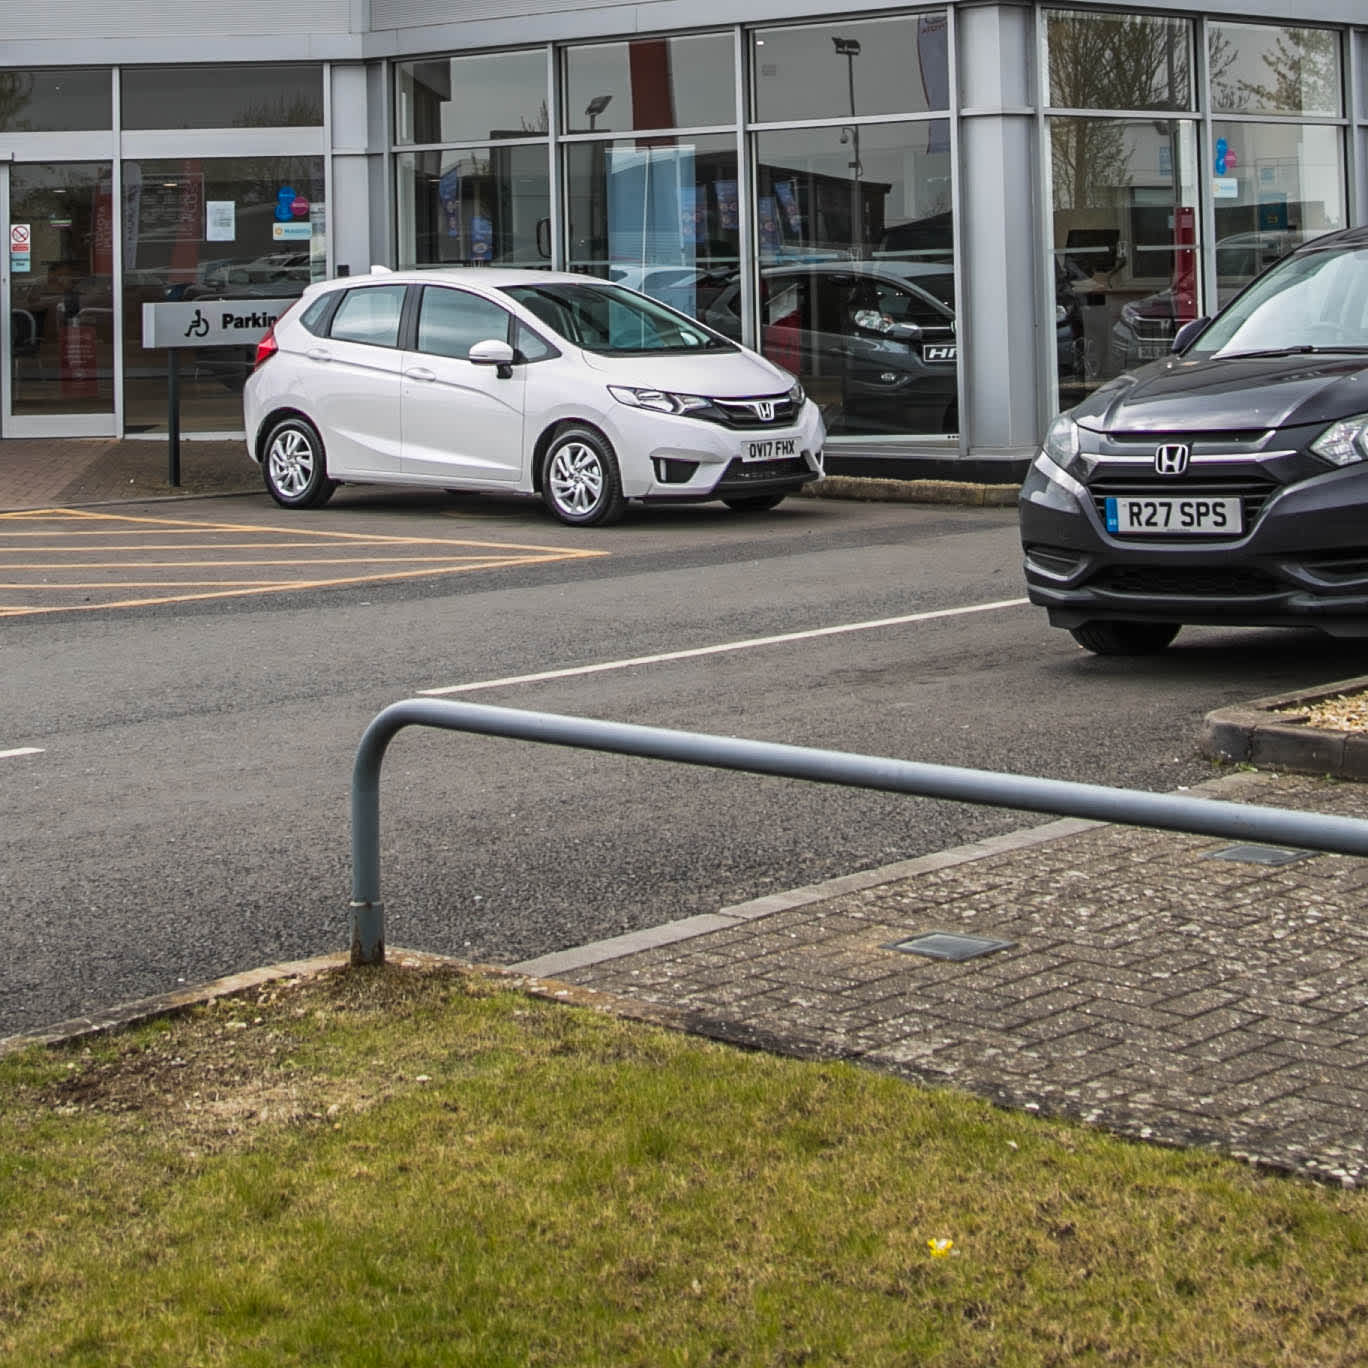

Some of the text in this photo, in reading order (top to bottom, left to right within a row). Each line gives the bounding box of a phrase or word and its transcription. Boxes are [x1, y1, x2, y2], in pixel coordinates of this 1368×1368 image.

[749, 440, 795, 458] OV17 FHX
[1128, 501, 1228, 527] R27 SPS
